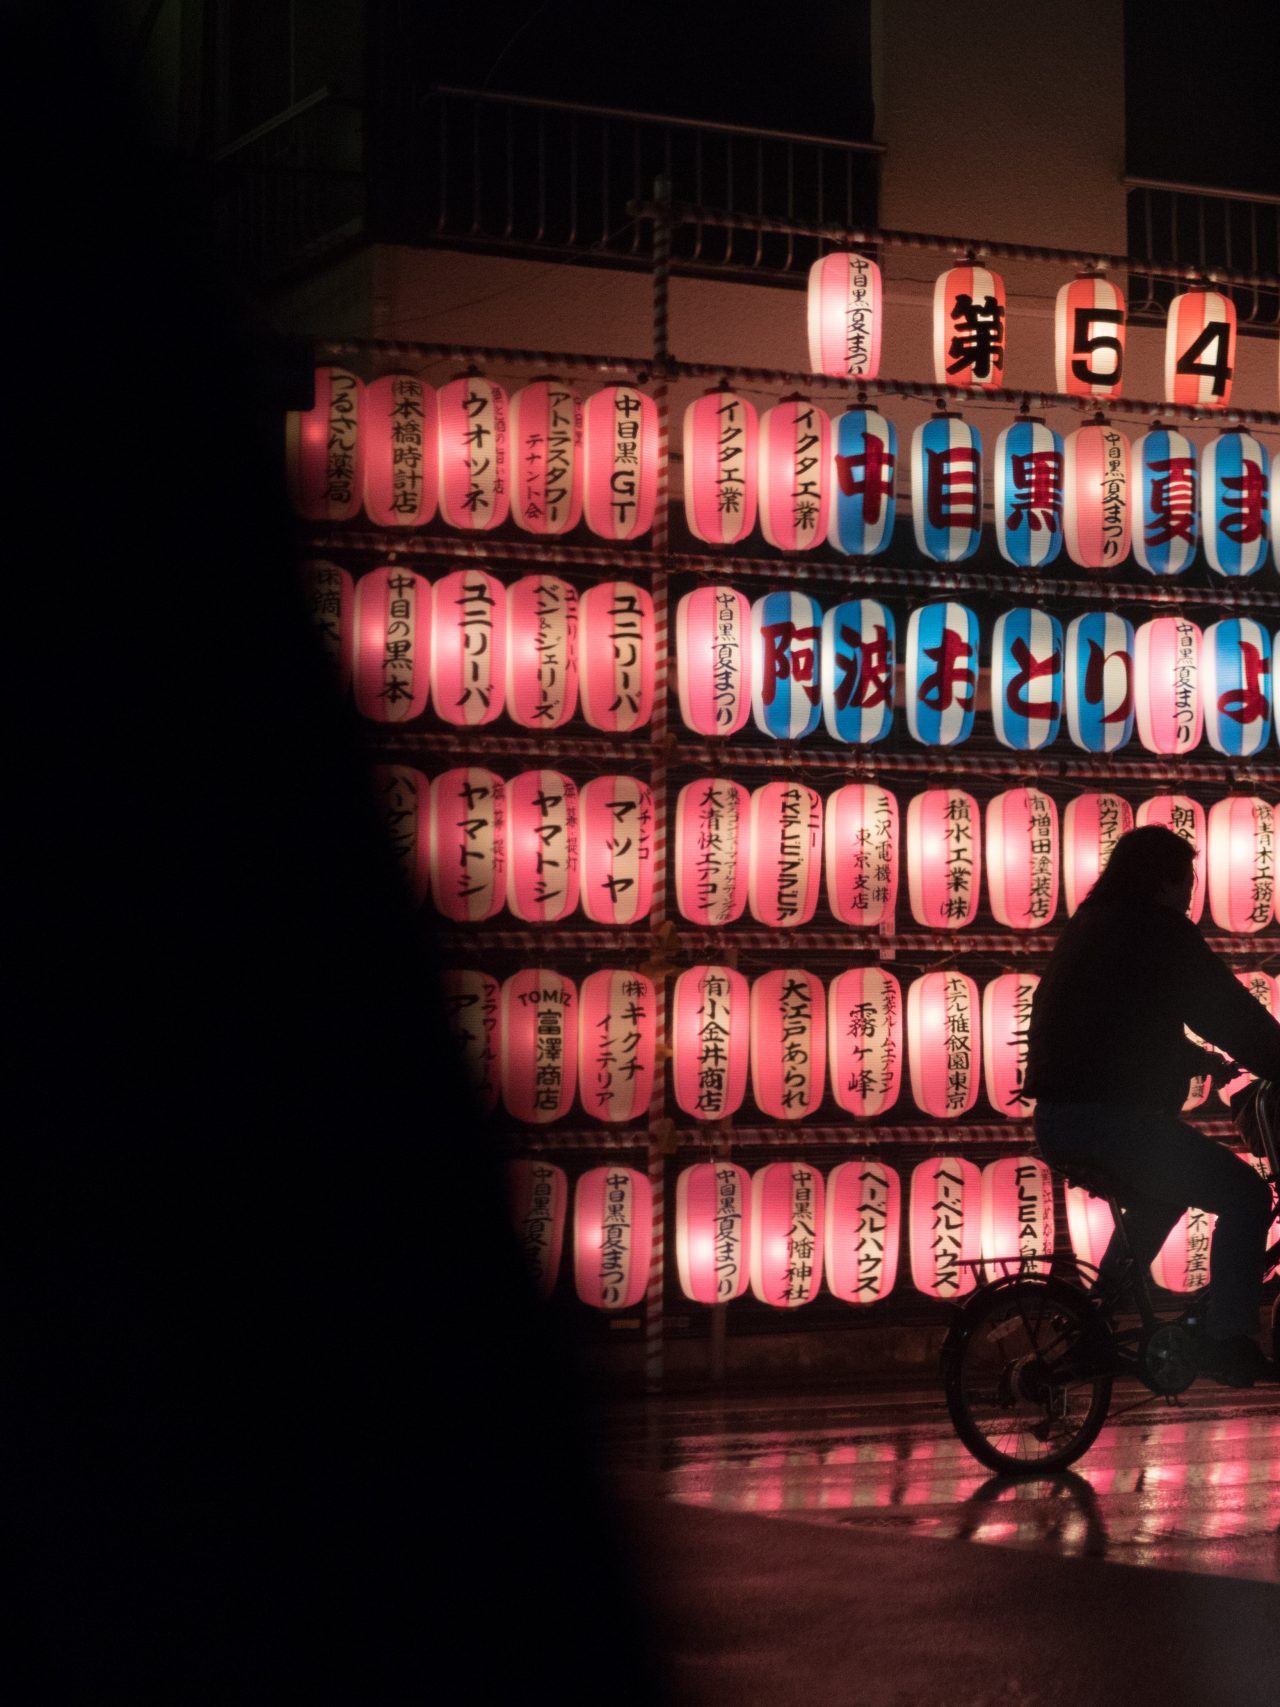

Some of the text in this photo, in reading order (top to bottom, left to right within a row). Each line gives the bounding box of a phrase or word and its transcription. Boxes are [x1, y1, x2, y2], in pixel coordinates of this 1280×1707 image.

[845, 258, 873, 374] 中目黒夏まつり
[326, 375, 357, 504] つるさん薬局
[461, 393, 490, 512] ウオツネ
[524, 434, 545, 519] テナント会
[544, 391, 573, 521] アトラスタワー
[610, 395, 642, 523] 中目黒GT
[716, 401, 744, 513] イクタ工業
[792, 408, 821, 530] イクタ工業
[1101, 433, 1126, 558] 中目黒夏まつり
[378, 574, 416, 703] 中目の黒本
[455, 584, 496, 709] ユニリーバ
[565, 588, 578, 673] ユニリーバ
[608, 595, 645, 713] ユニリーバ
[712, 593, 739, 726] 中目黒夏まつり
[1173, 623, 1197, 743] 中目黒夏まつり
[456, 781, 489, 899] ヤマトシ
[531, 790, 562, 903] ヤマトシ
[602, 801, 636, 904] マツヤ
[637, 791, 652, 861] パチンコ
[697, 787, 723, 909] 大清快エアコン
[807, 793, 820, 848] ソニー
[851, 828, 873, 910] 東京支店
[533, 1009, 563, 1110] 富澤商店
[595, 1014, 616, 1106] インテリア
[779, 979, 812, 1108] 大江戸あられ
[880, 980, 896, 1094] 三菱ルームエアコン
[944, 978, 971, 1110] ホテル雅叙園東京
[522, 1167, 554, 1279] 中目黒夏まつ
[600, 1174, 631, 1304] 中目黒夏まつり
[714, 1170, 741, 1296] 中目黒夏まつり
[778, 1170, 816, 1301] 中目黒八幡神社
[851, 1171, 889, 1294] ヘーベルハウス
[931, 1169, 964, 1290] ヘーベルハウス
